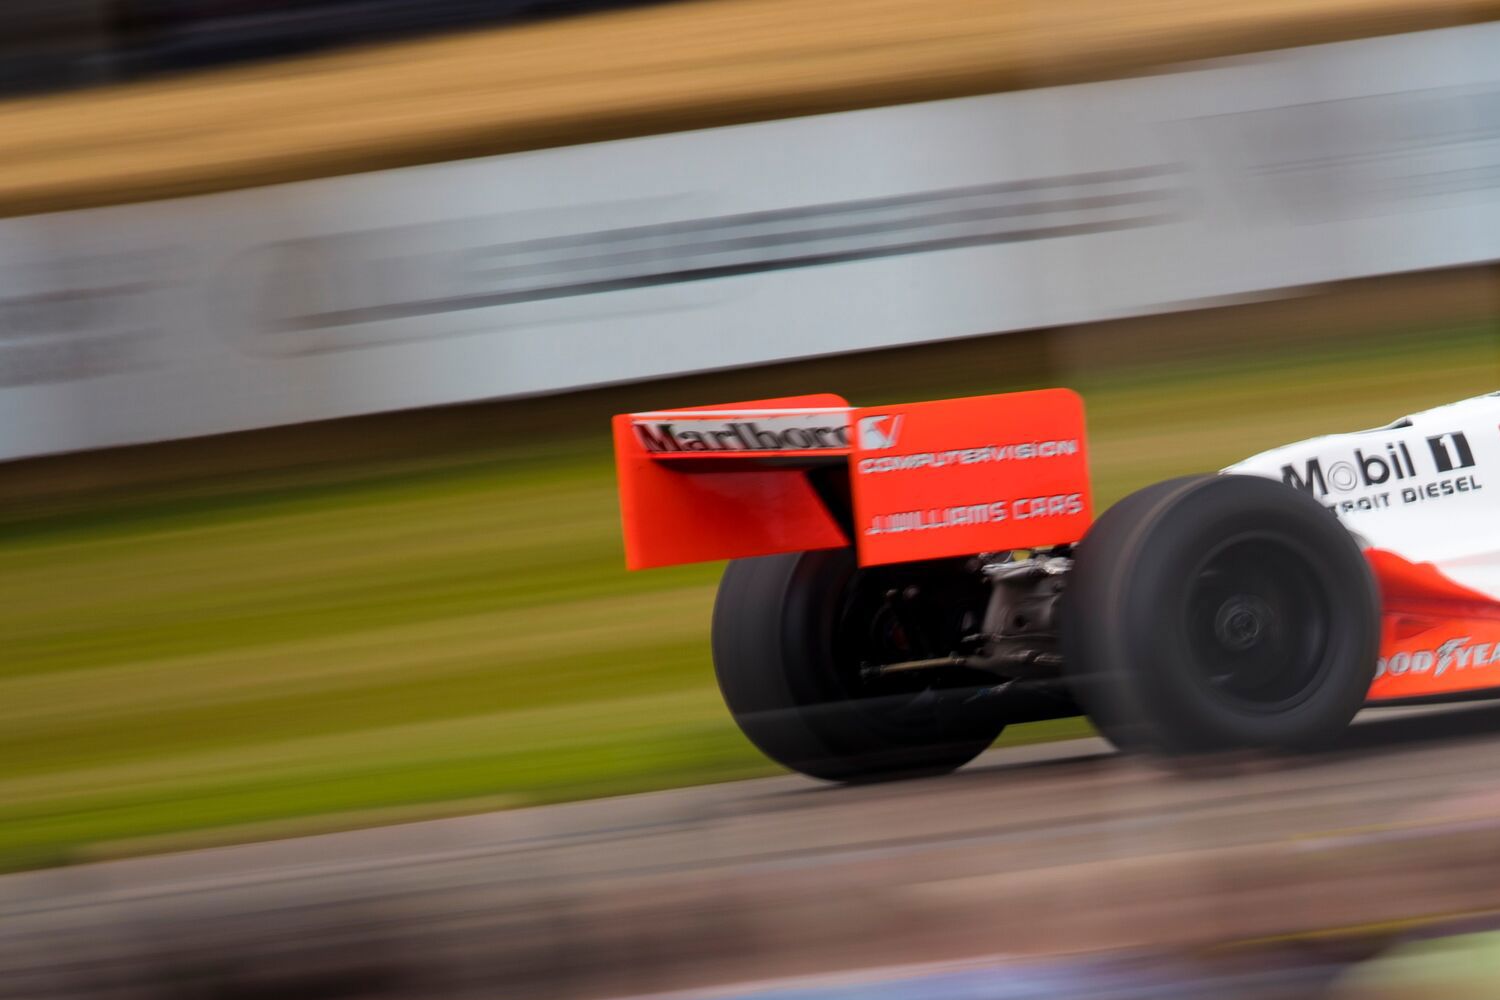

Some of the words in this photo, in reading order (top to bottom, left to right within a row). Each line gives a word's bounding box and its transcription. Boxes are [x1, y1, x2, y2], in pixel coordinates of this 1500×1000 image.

[858, 439, 1078, 475] COMPUTERVISION
[1281, 440, 1417, 497] Mobil
[1437, 432, 1464, 470] 1
[1012, 493, 1083, 520] CARS
[1327, 492, 1390, 517] TROIT
[1402, 475, 1482, 504] DIESEL
